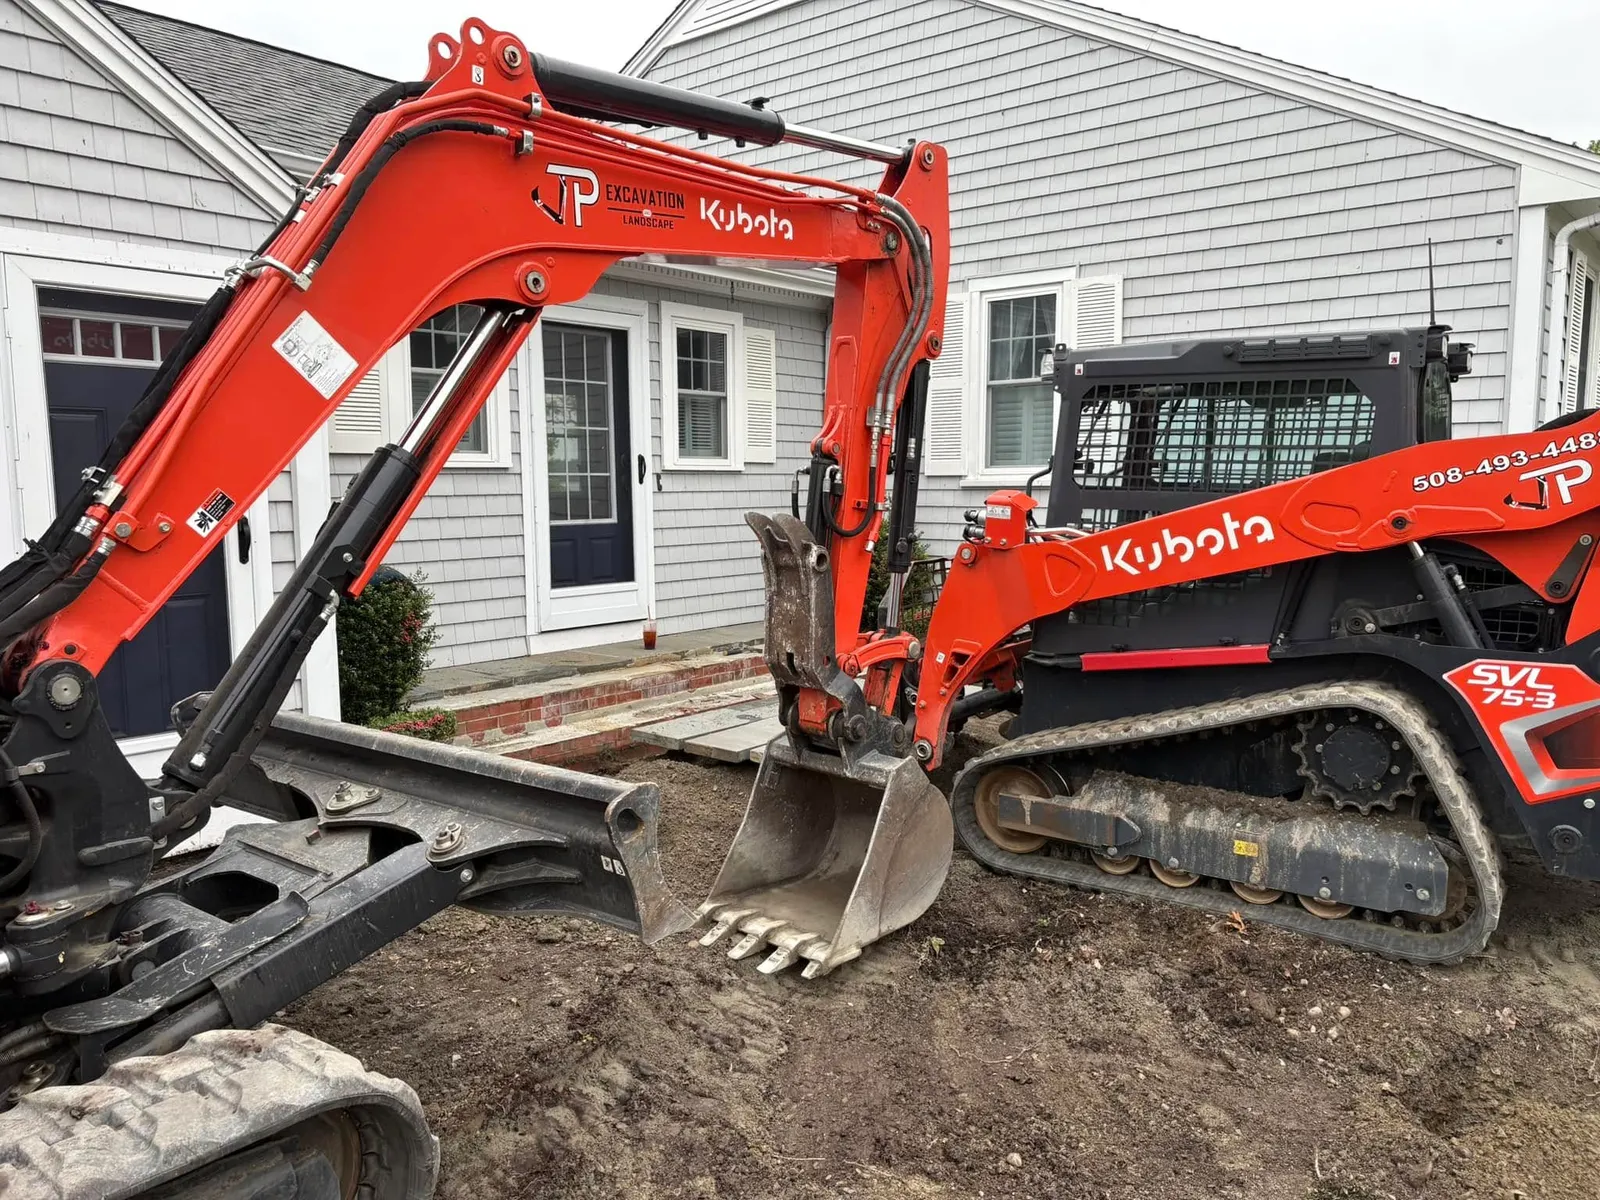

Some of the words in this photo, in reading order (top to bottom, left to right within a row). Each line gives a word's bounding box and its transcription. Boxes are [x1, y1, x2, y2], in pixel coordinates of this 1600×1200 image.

[605, 184, 685, 210] EXCAVATION
[622, 214, 674, 230] LANDSCAPE
[700, 197, 793, 241] Kubota
[1412, 429, 1600, 493] 508-493-448
[1100, 512, 1275, 576] Kubota
[1467, 664, 1555, 690] SVL
[1481, 688, 1557, 709] 75-3
